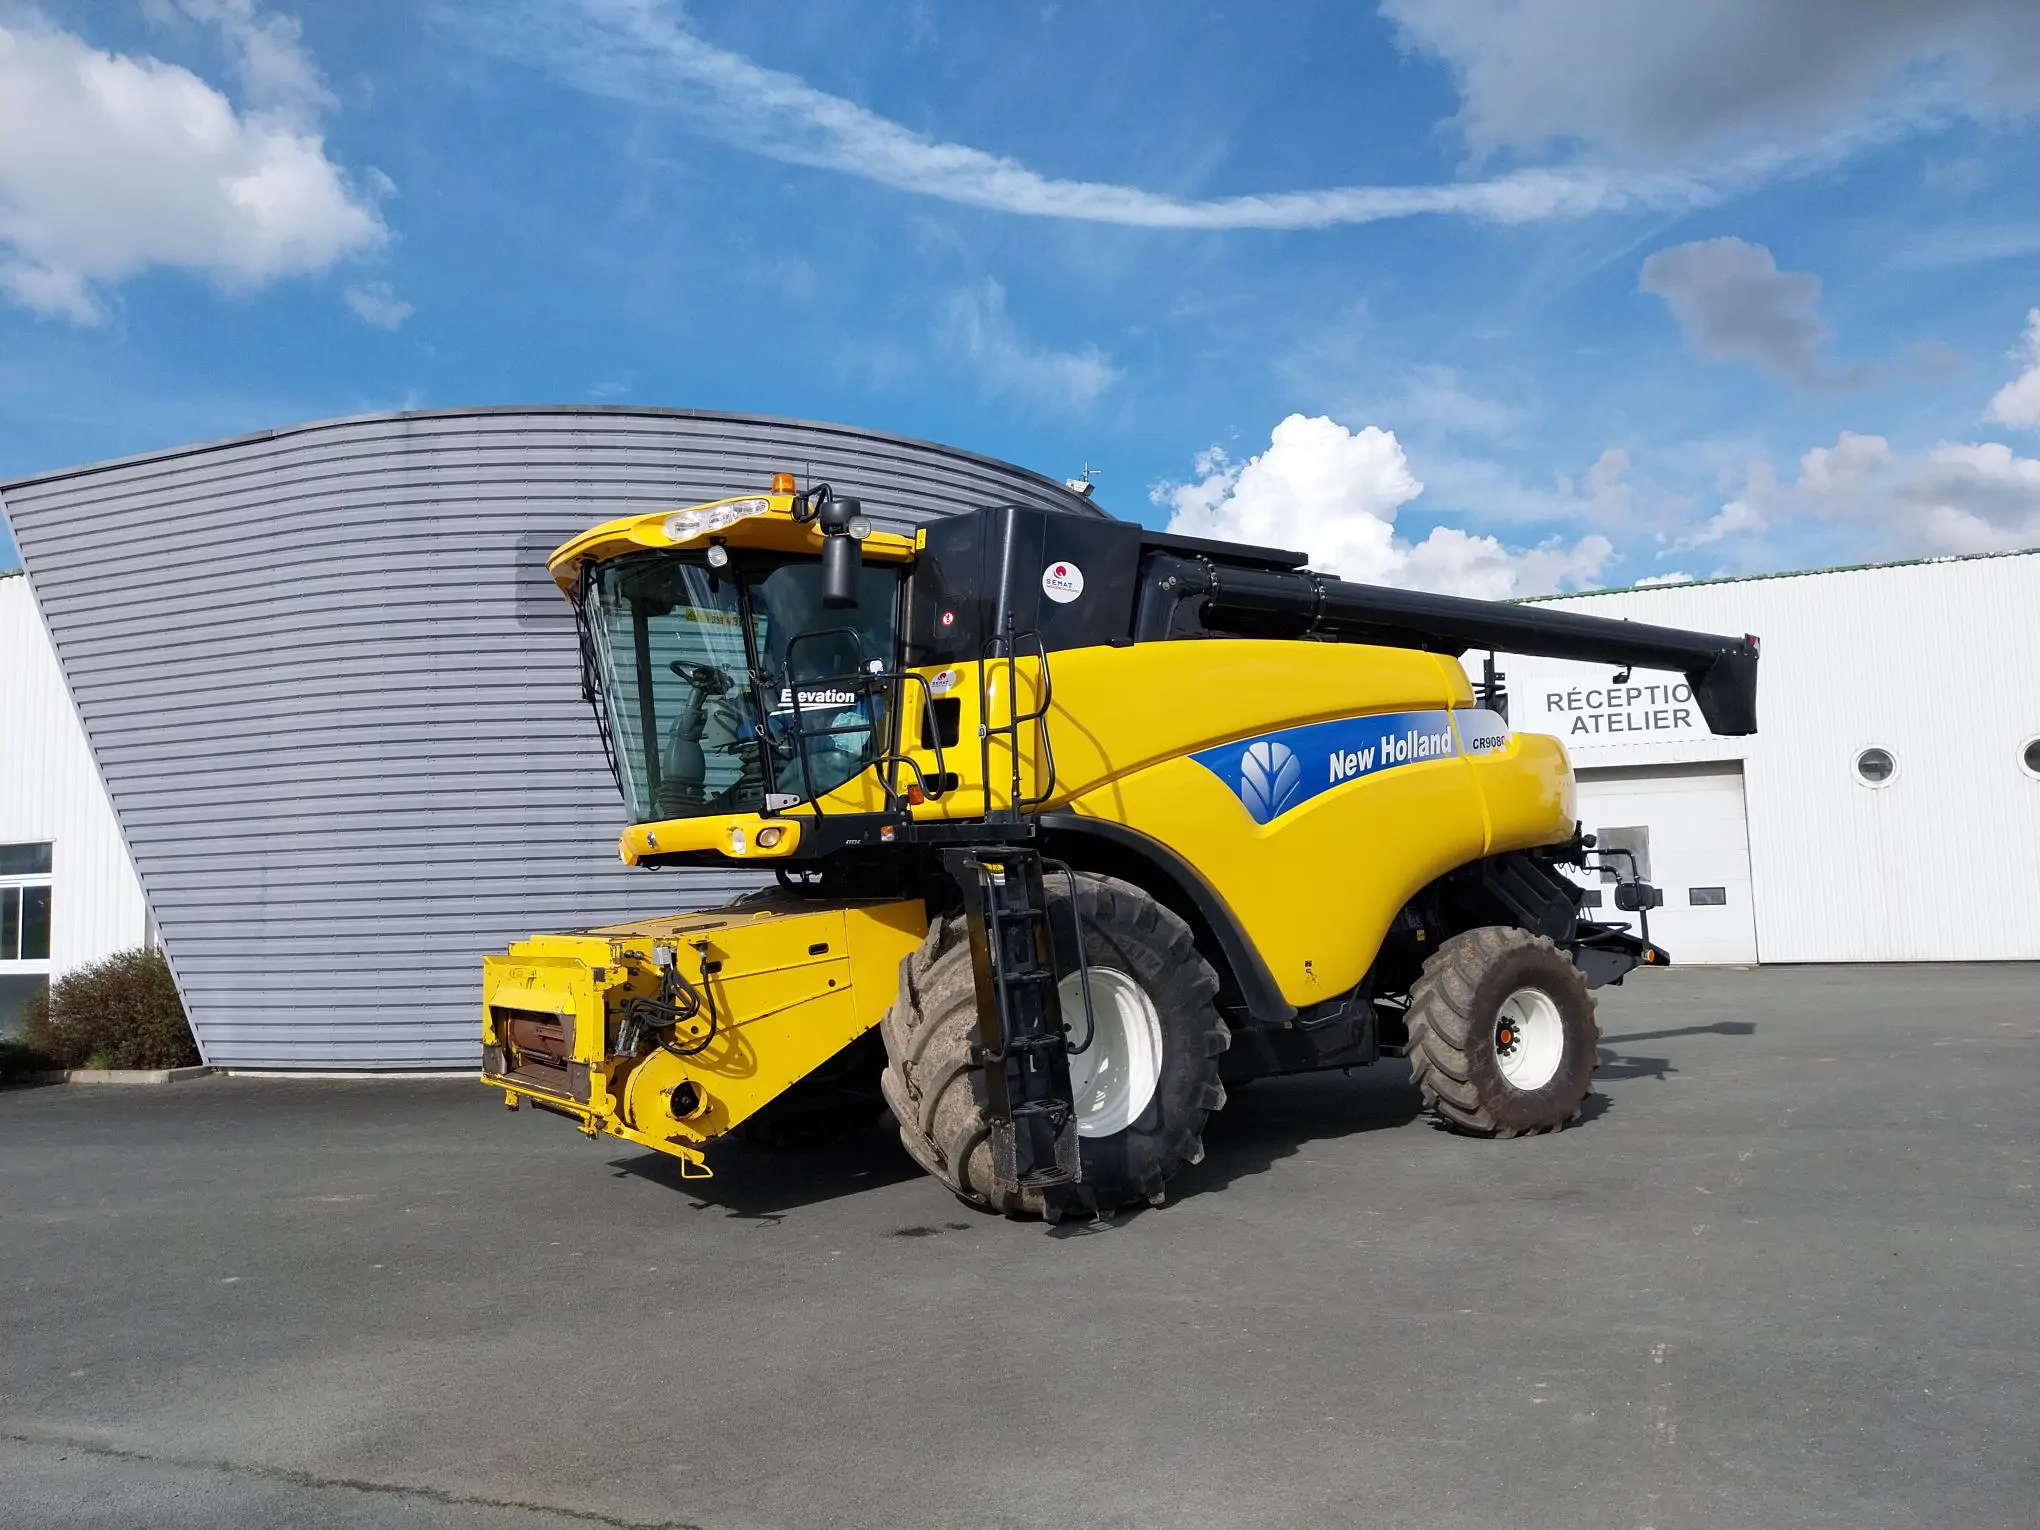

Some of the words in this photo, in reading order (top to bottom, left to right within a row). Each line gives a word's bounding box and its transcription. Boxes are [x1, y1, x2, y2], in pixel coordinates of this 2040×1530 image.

[1046, 578, 1073, 588] SEMAT
[780, 688, 855, 703] Eevation
[1546, 683, 1693, 712] RÉCEPTIO
[1570, 708, 1692, 735] ATELIER
[1329, 748, 1375, 783] New
[1380, 725, 1452, 765] Holland
